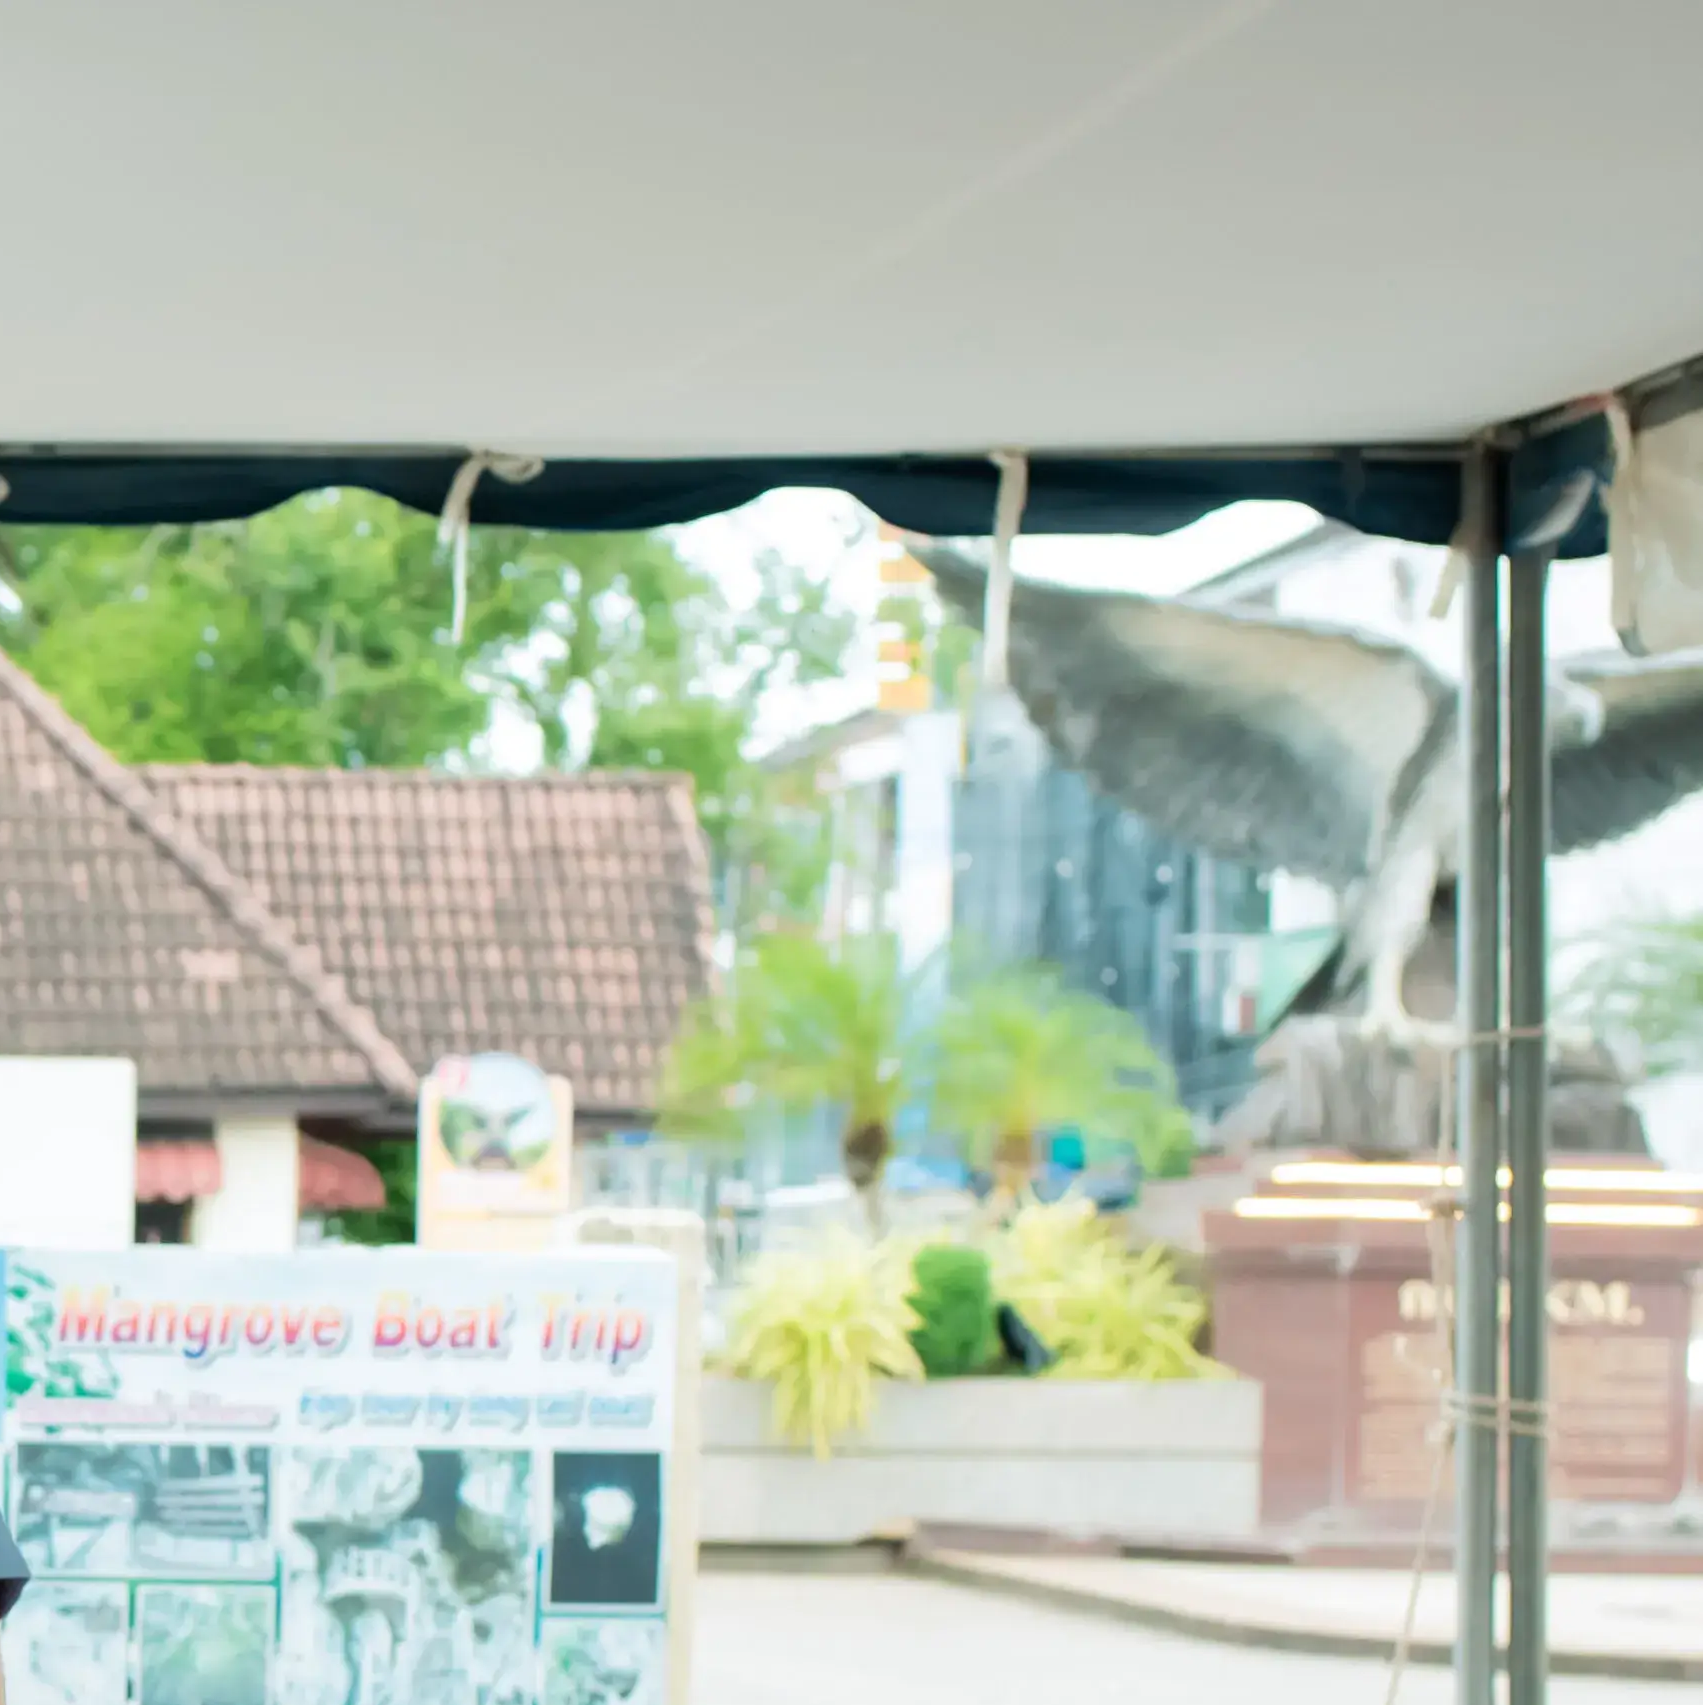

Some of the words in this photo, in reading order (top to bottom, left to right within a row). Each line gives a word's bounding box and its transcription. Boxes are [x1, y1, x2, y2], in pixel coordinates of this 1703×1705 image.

[57, 1284, 343, 1361] Mangrove
[373, 1290, 509, 1352] Boat
[539, 1291, 647, 1366] Trip
